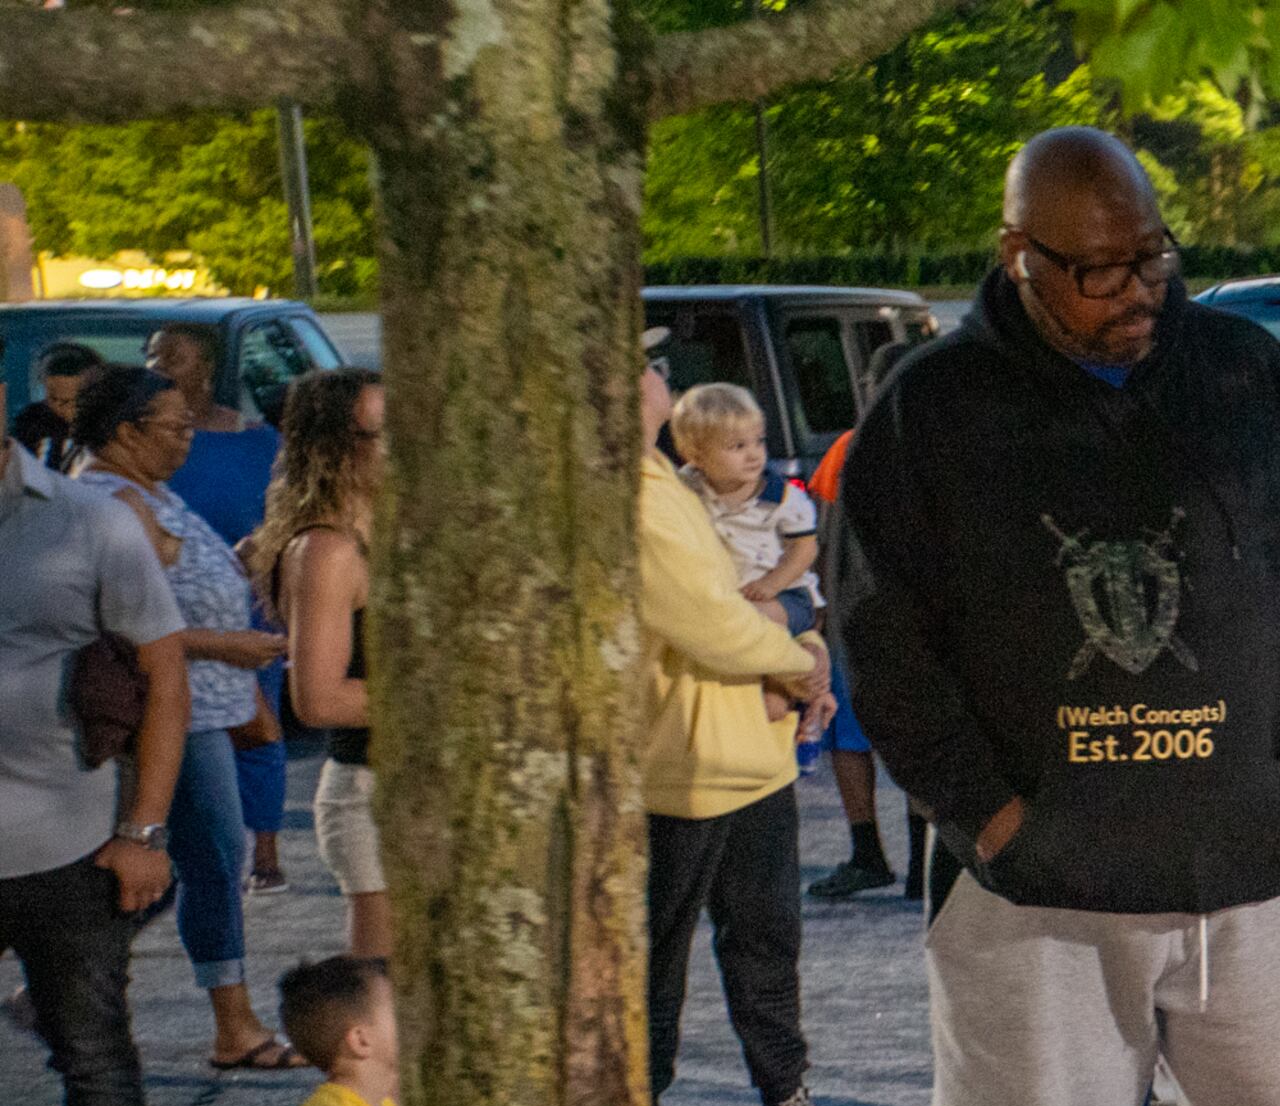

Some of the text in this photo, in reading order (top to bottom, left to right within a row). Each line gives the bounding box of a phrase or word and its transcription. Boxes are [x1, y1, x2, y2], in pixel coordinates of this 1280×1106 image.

[1057, 700, 1225, 729] (Welch Concepts)
[1068, 728, 1214, 762] Est. 2006
